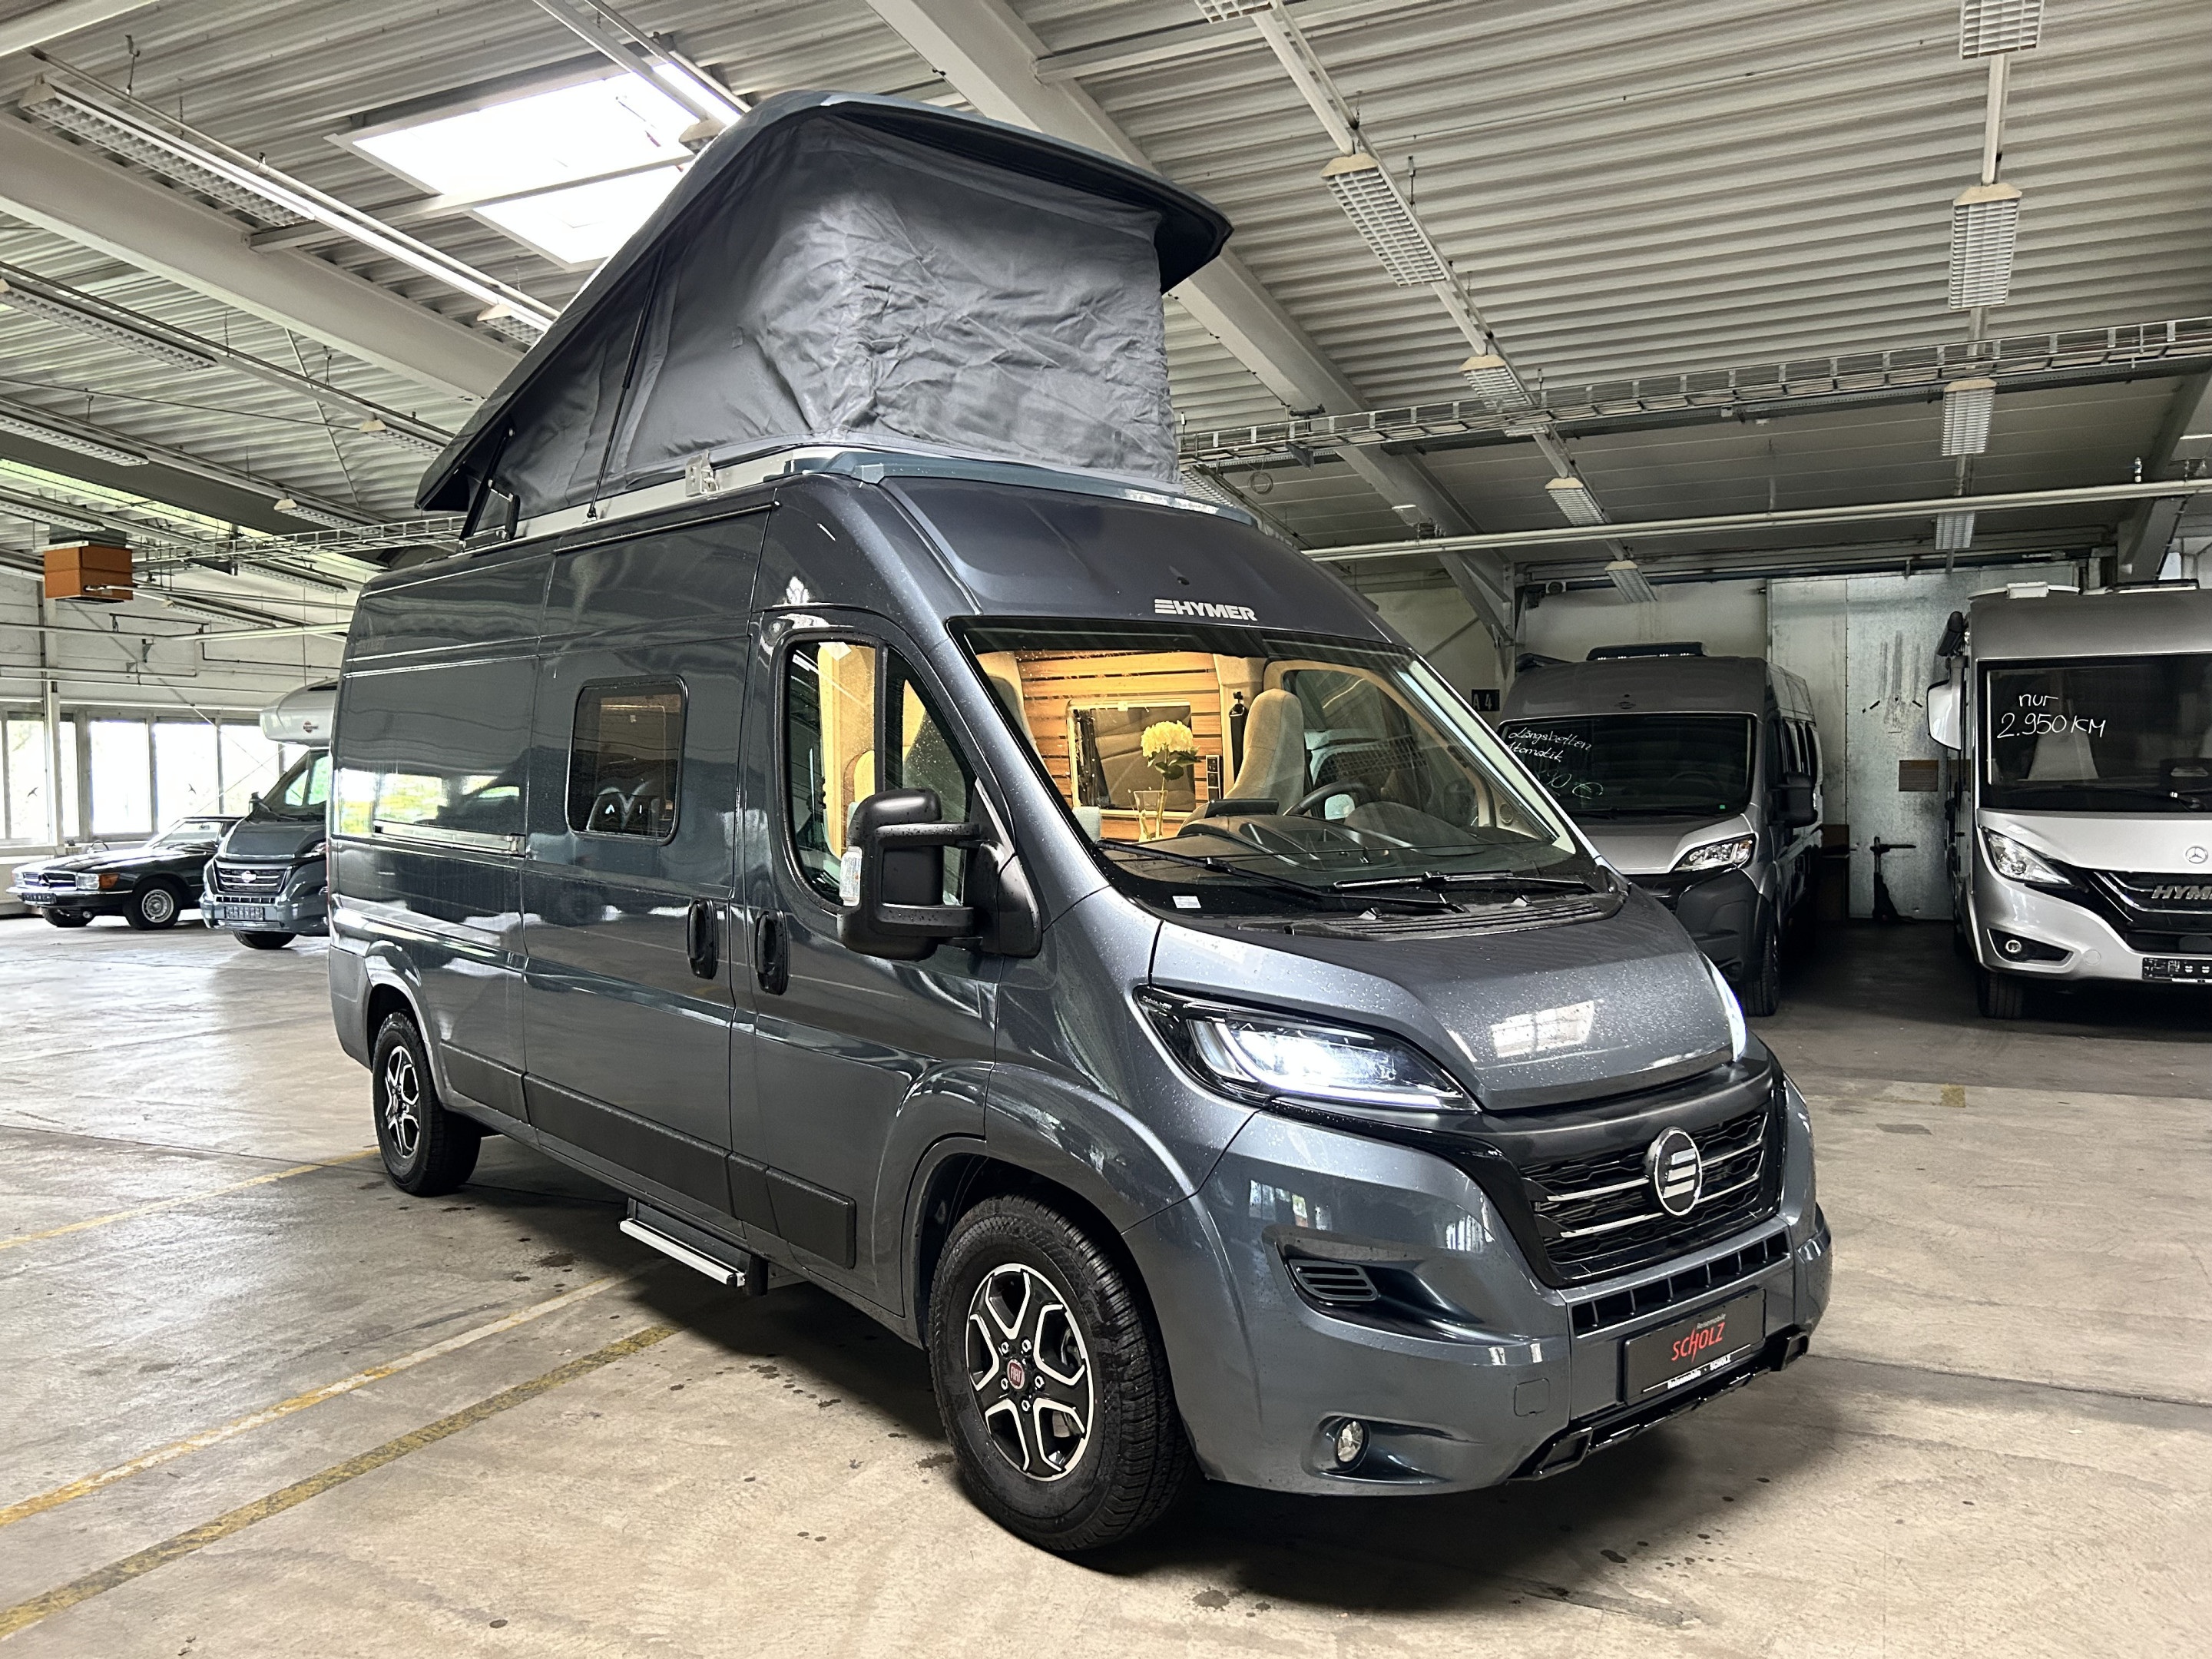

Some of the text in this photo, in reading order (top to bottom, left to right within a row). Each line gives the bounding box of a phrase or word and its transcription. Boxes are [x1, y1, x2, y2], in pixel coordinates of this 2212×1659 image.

[1173, 600, 1258, 621] HYMER
[2018, 694, 2059, 707] nur
[1997, 713, 2068, 739] 2.950
[2151, 886, 2212, 900] HYM
[1671, 1322, 1726, 1363] SCHOLZ
